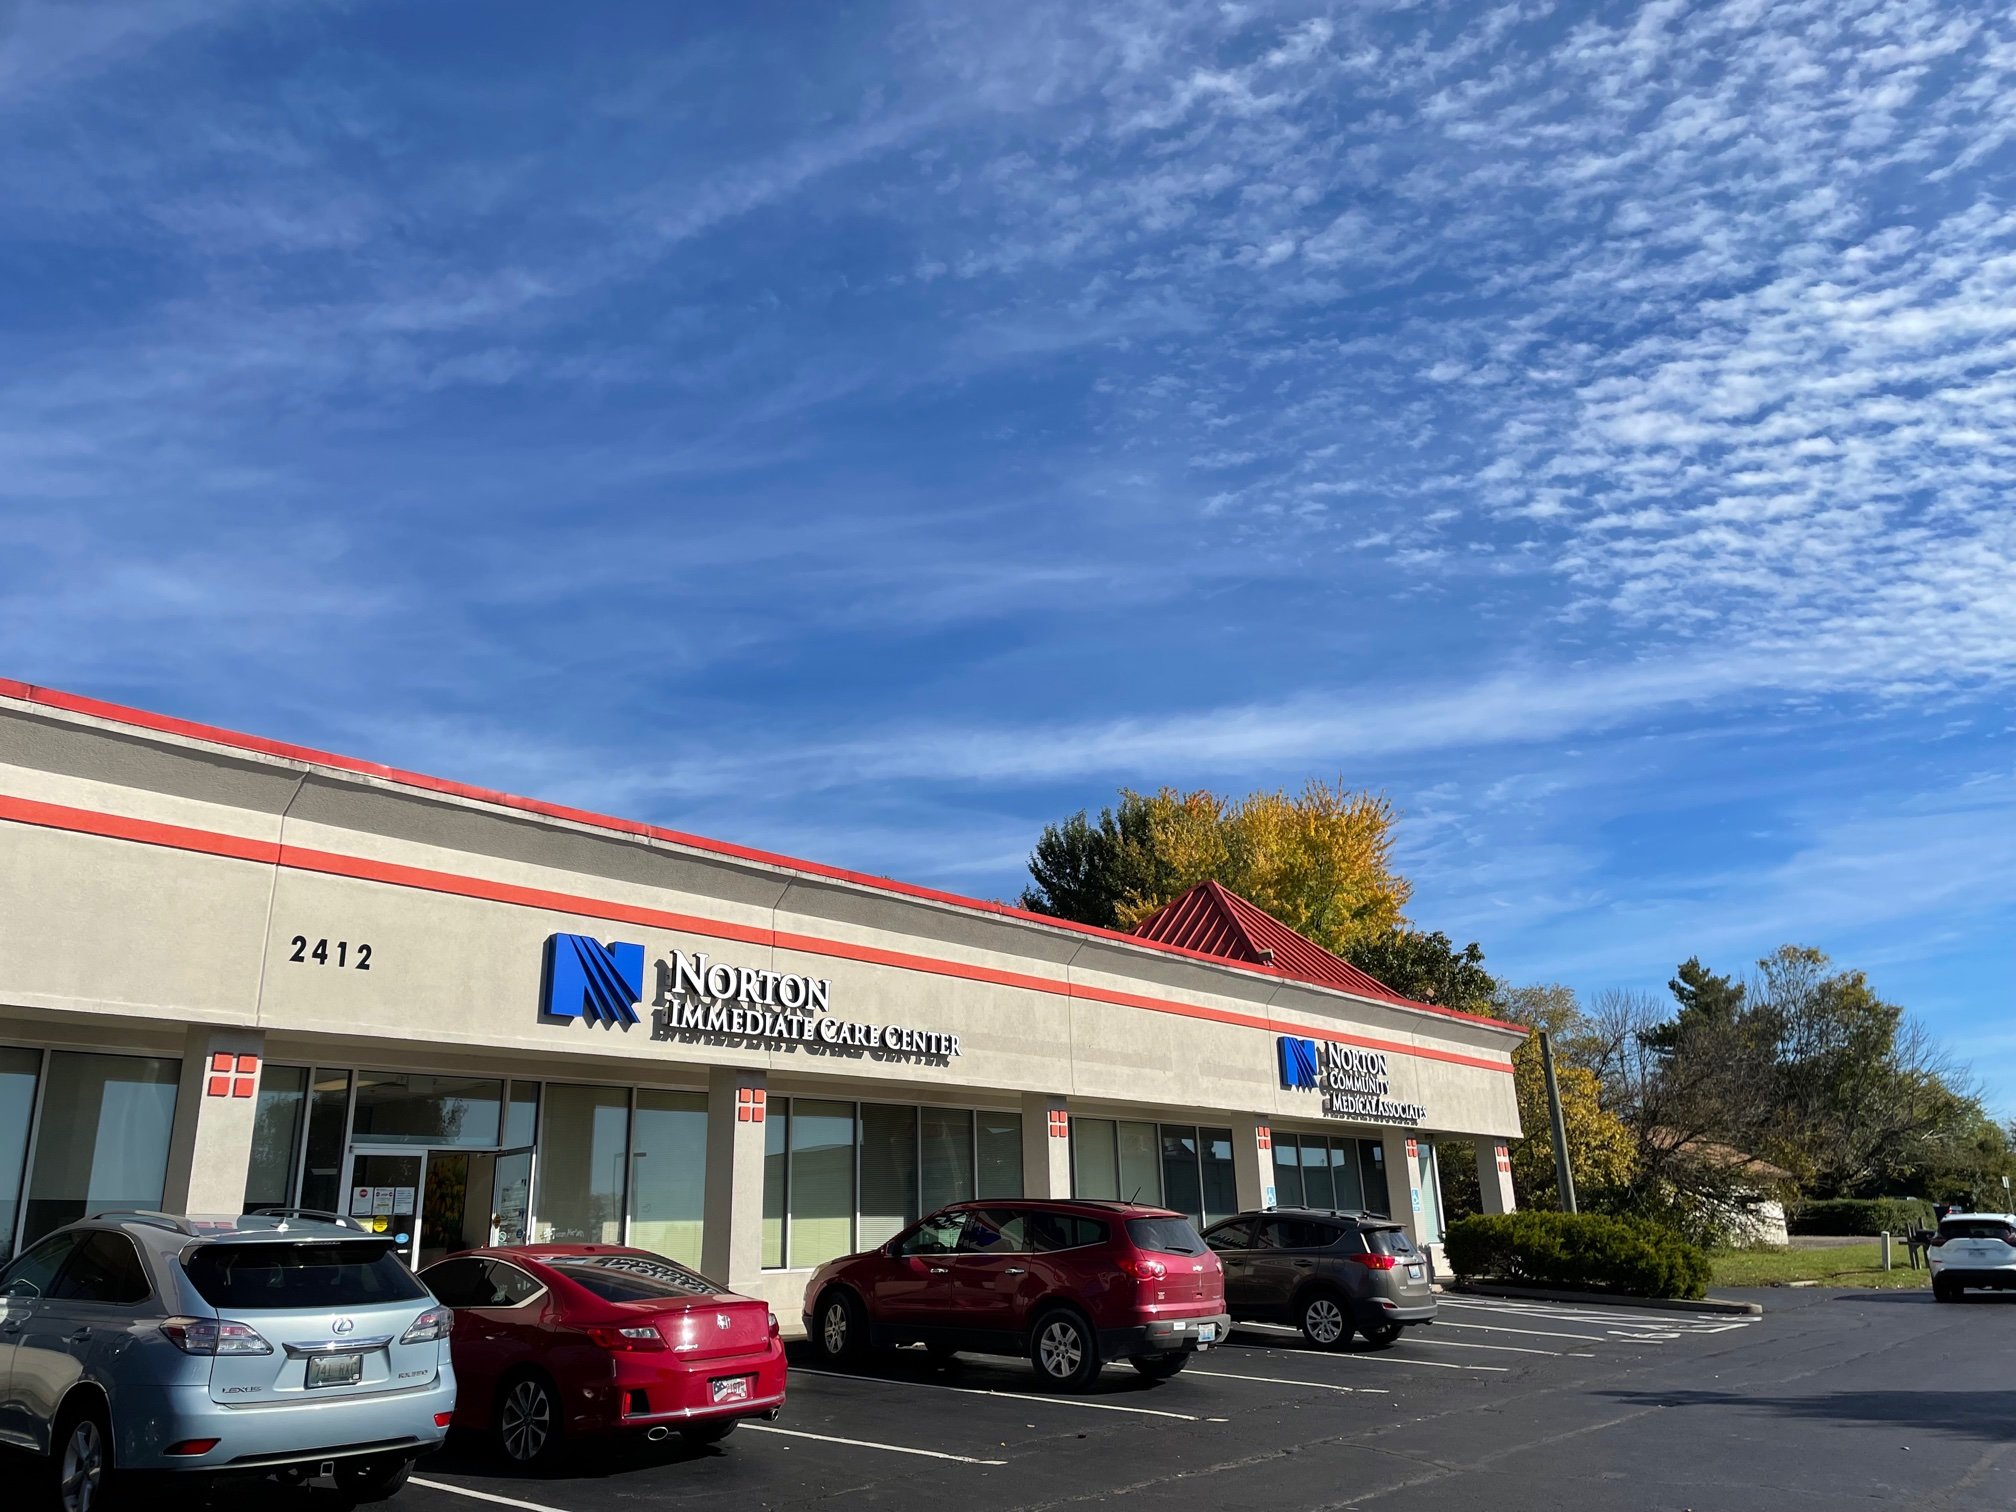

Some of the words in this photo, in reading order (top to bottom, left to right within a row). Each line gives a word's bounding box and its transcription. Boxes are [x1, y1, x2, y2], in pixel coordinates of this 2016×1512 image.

[288, 935, 372, 970] 2412
[671, 949, 831, 1012] NORTON
[667, 999, 814, 1040] IMMEDIATE
[820, 1016, 880, 1048] CARE
[884, 1025, 962, 1056] CENTER
[1327, 1041, 1388, 1075] NORTON
[1329, 1071, 1391, 1095] COMMUNITY
[1332, 1093, 1378, 1115] MEDICAL
[1378, 1101, 1428, 1120] ASSOCIATES
[222, 1386, 262, 1394] LEXUS
